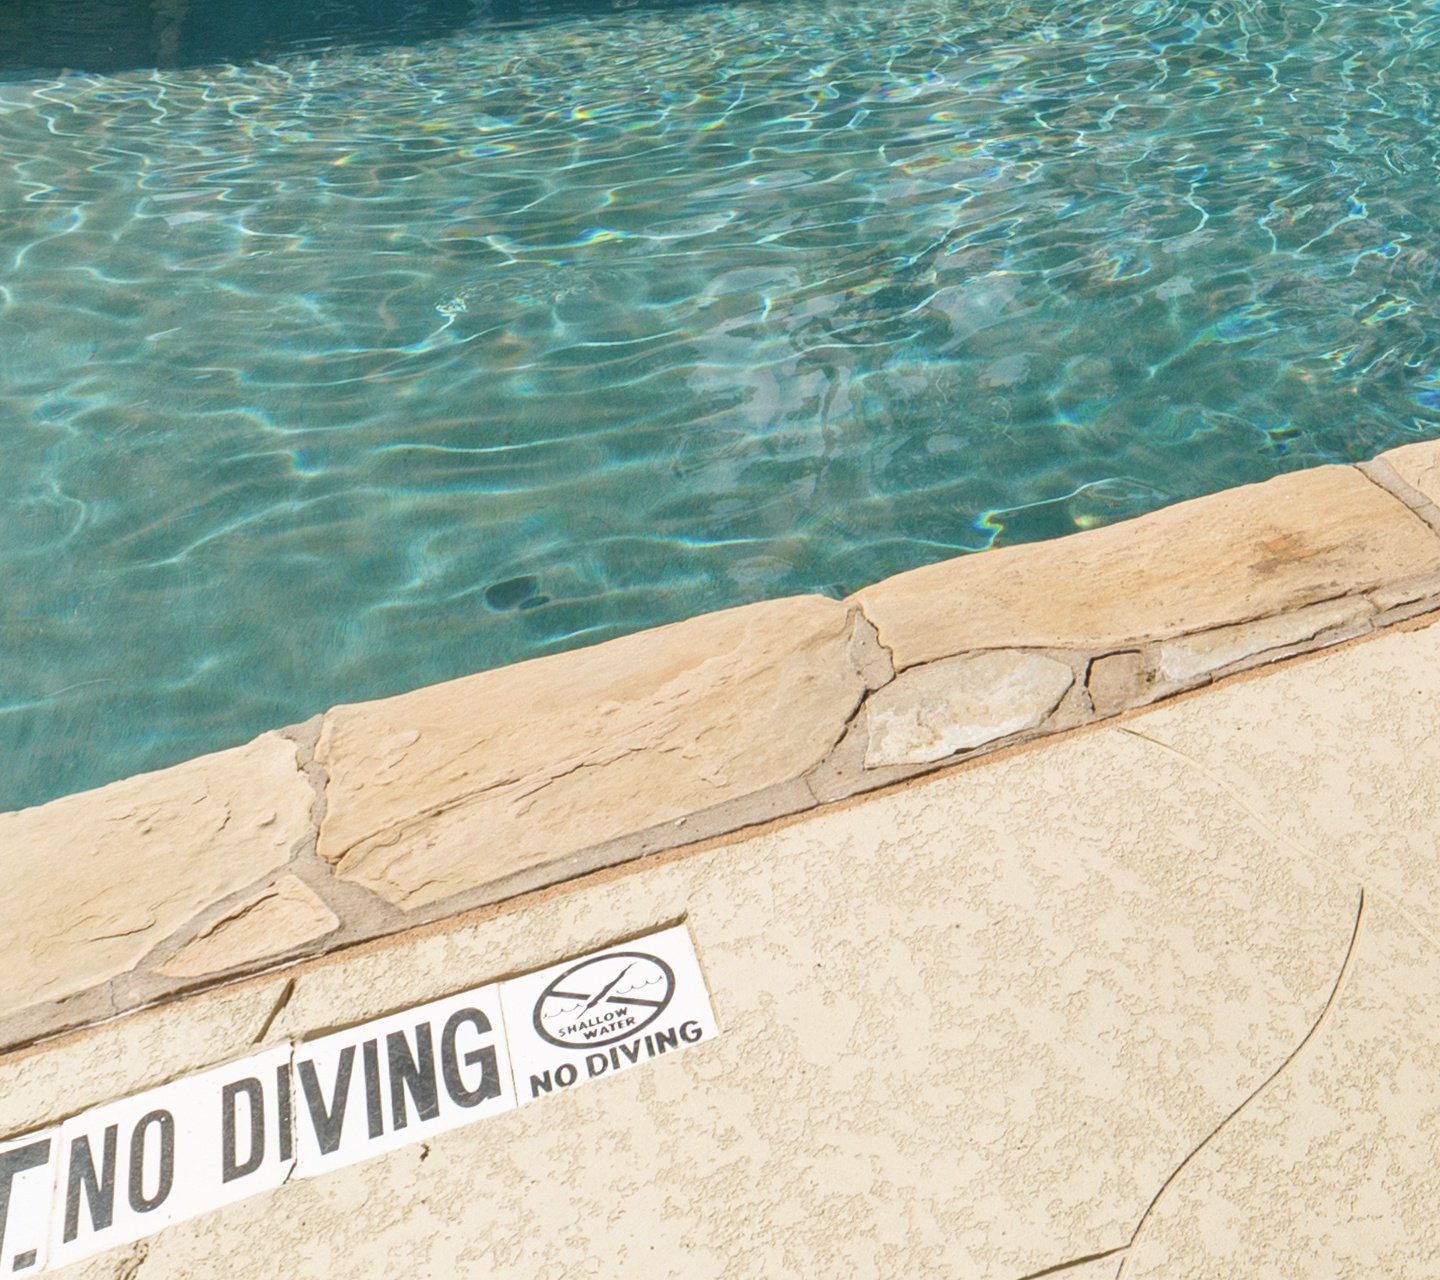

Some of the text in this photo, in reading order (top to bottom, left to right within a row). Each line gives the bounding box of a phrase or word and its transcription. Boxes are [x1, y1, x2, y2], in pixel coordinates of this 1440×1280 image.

[558, 1006, 629, 1038] SHALLOW
[583, 1016, 637, 1041] WATER
[529, 1019, 703, 1099] NO DIVING
[63, 1108, 175, 1245] NO
[221, 1006, 502, 1184] DIVING
